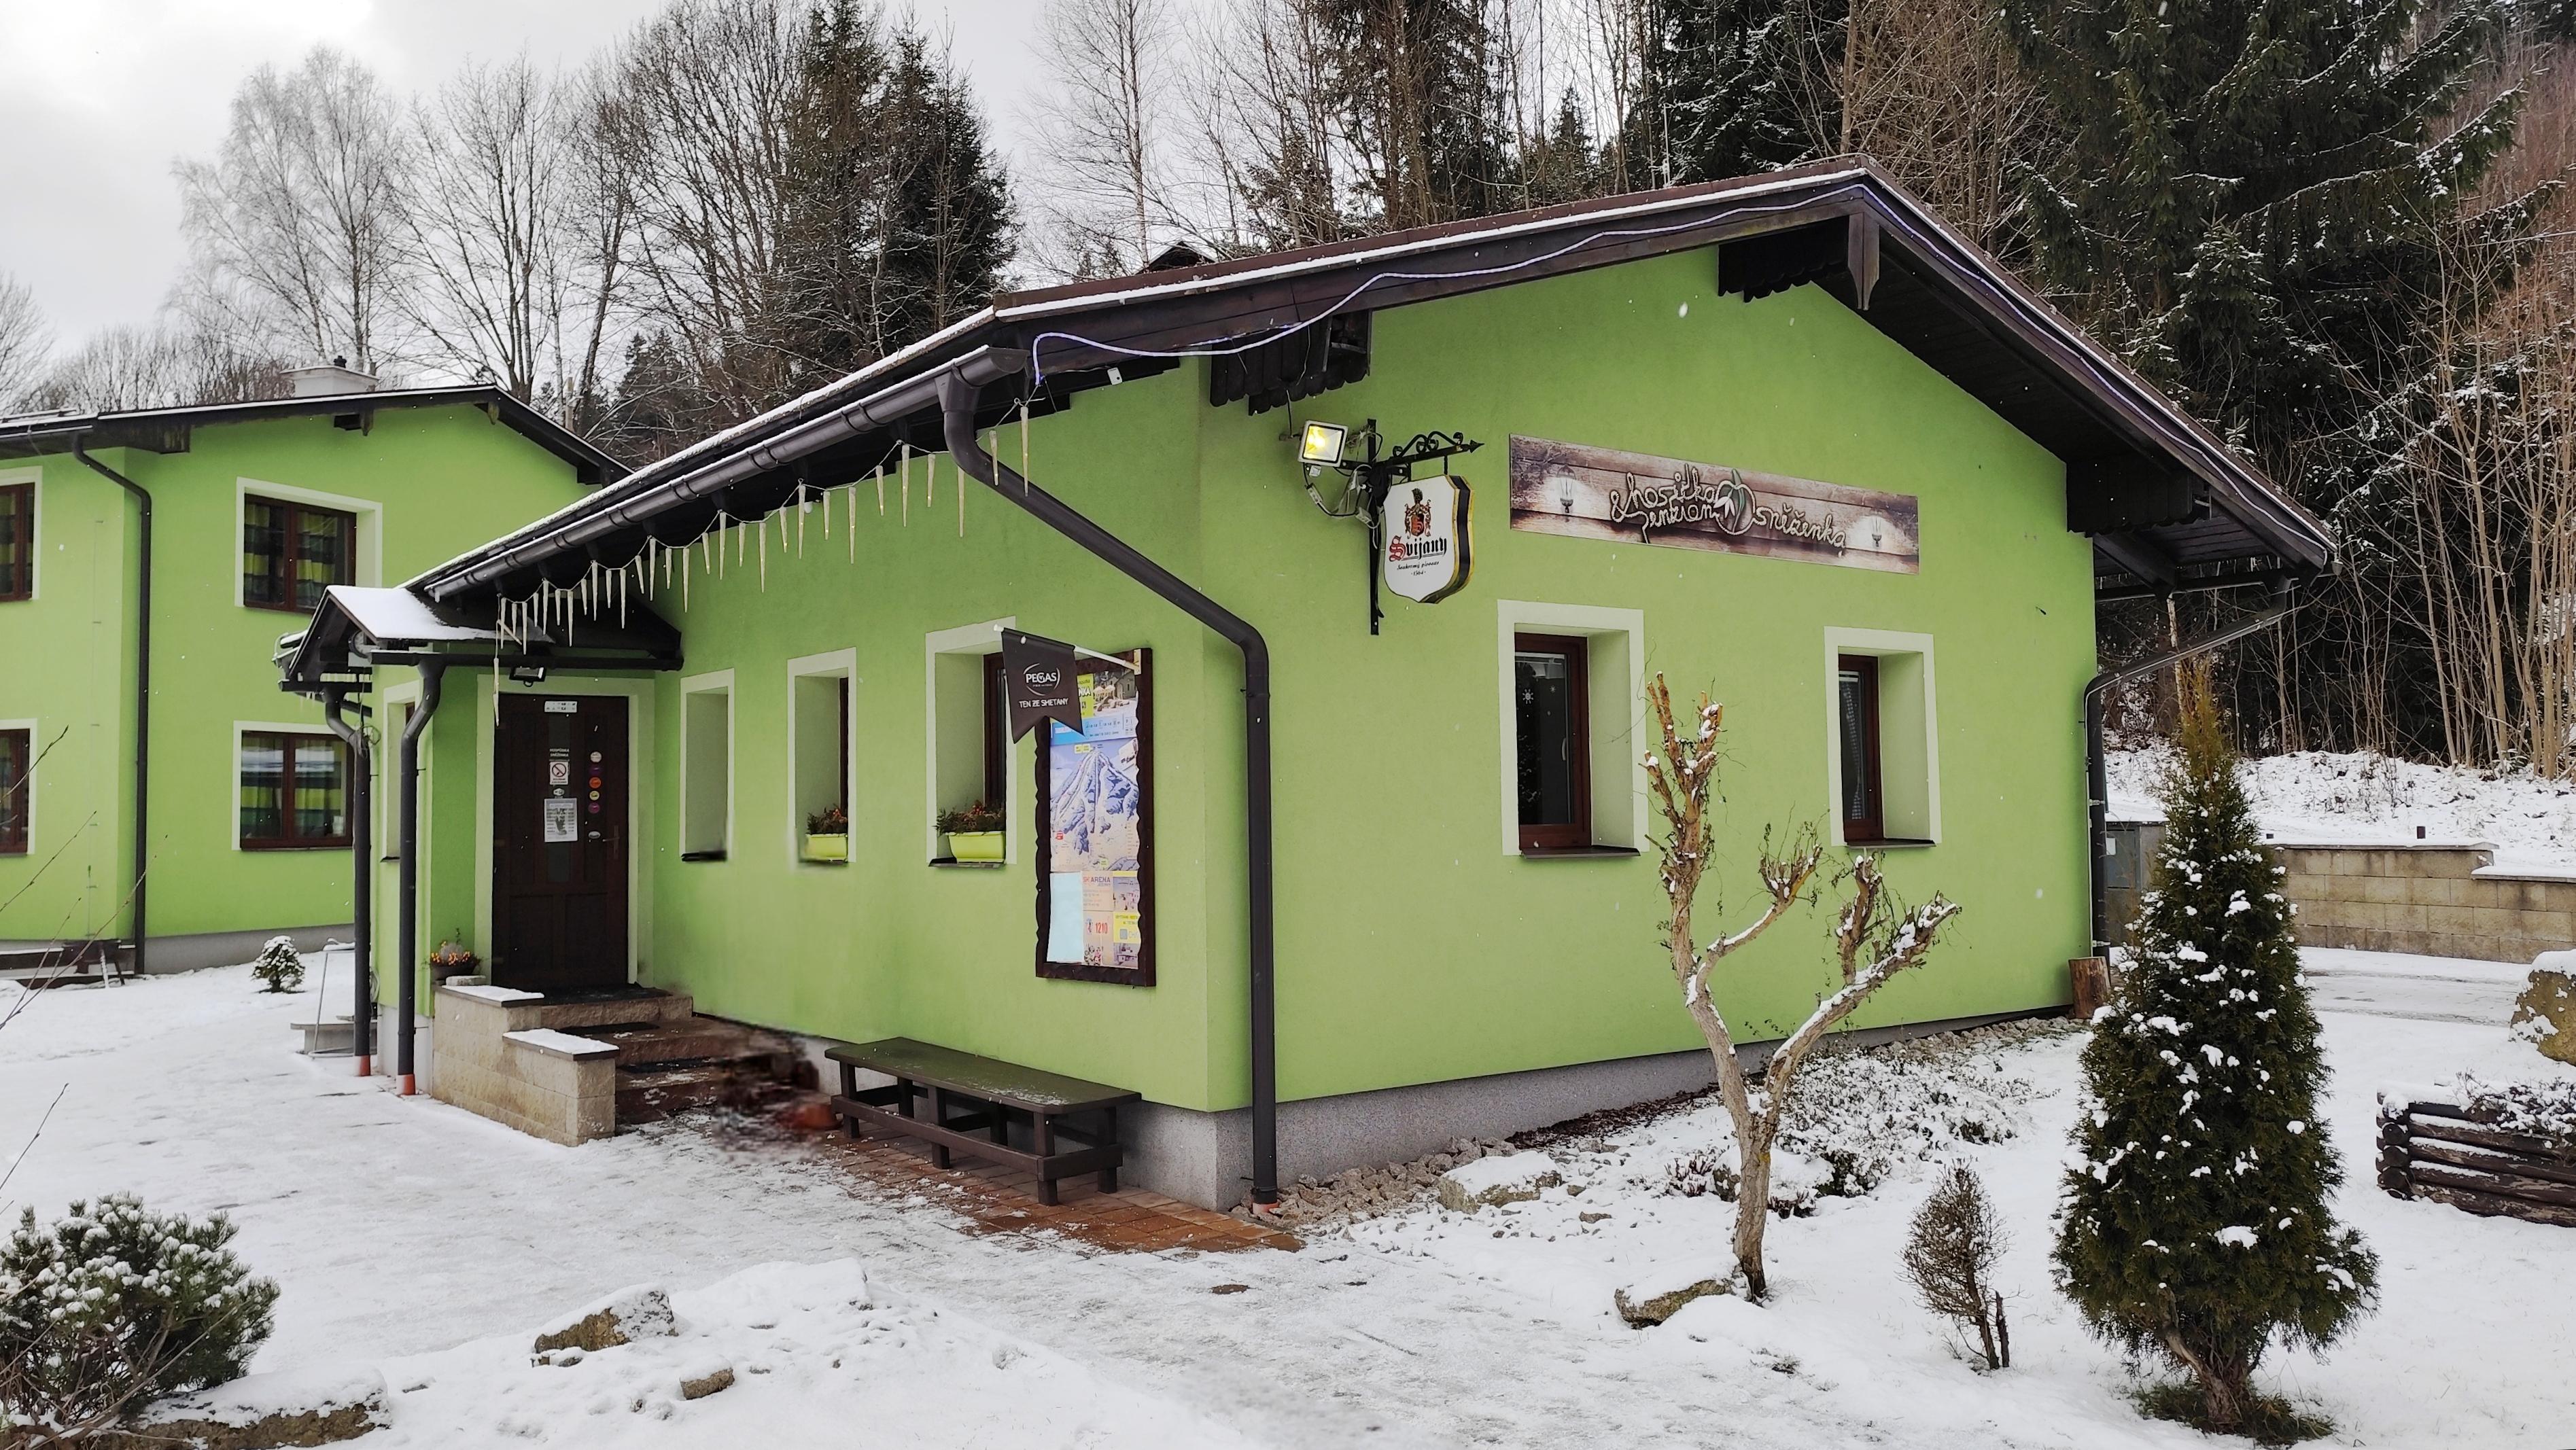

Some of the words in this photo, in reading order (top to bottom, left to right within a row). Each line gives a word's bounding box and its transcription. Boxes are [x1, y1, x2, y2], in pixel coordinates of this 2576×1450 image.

[1389, 535, 1447, 562] Svijany
[1026, 673, 1057, 684] PEGAS
[1041, 698, 1068, 707] SMETANY
